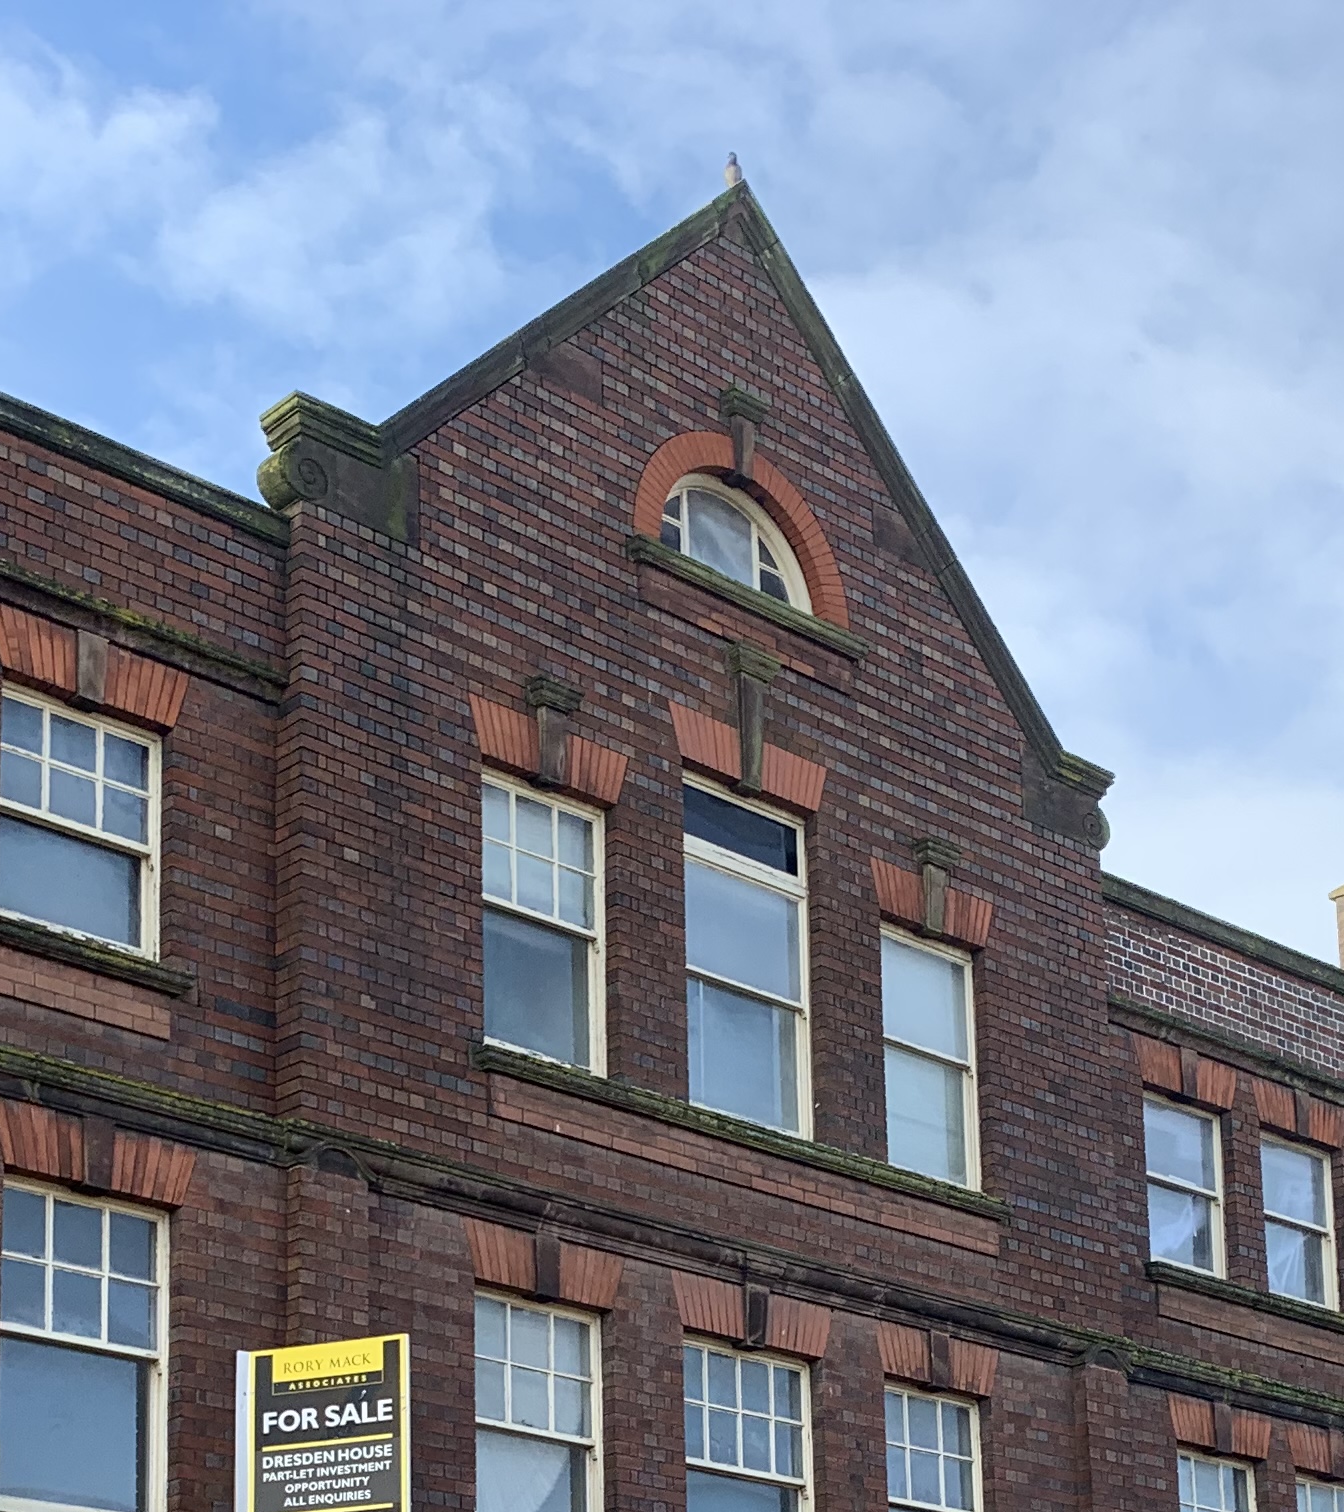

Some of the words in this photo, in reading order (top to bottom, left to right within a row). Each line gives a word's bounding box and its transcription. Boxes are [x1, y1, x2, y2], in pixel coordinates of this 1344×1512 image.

[283, 1358, 324, 1374] RORY
[329, 1353, 372, 1369] MACK
[288, 1374, 368, 1390] ASSOCIATES
[262, 1407, 320, 1435] FOR
[324, 1398, 394, 1428] SALE
[262, 1450, 335, 1469] DRESDEN
[338, 1444, 393, 1462] HOUSE
[262, 1468, 315, 1483] PART-LET
[316, 1460, 392, 1478] INVESTMENT
[284, 1476, 370, 1494] OPPORTUNITY
[283, 1495, 307, 1507] ALL
[308, 1489, 372, 1506] ENQUIRIES
